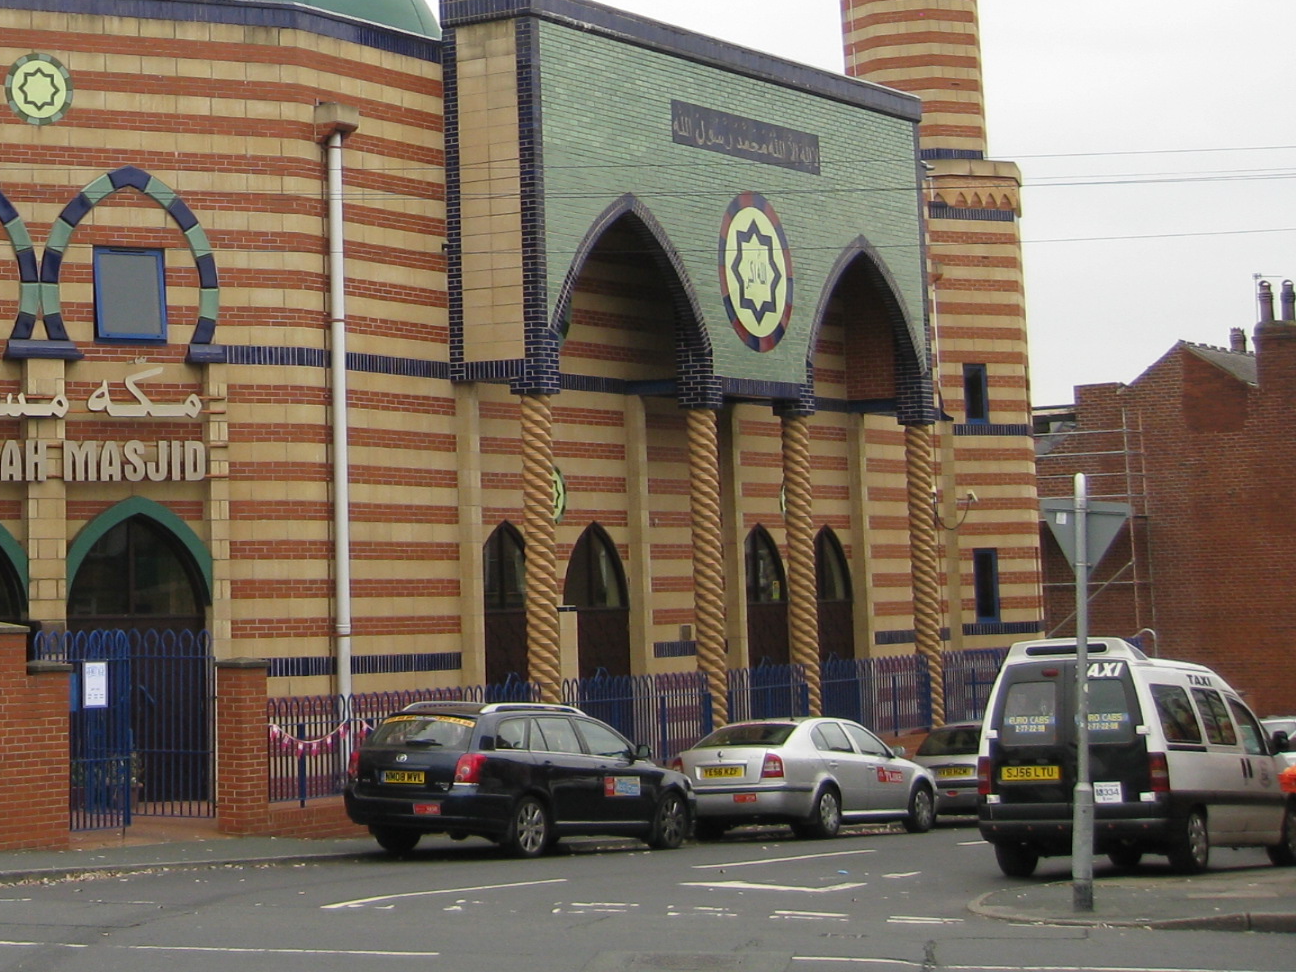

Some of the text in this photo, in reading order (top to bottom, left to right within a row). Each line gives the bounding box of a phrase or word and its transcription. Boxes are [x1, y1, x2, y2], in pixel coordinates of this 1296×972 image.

[63, 440, 206, 482] MASJID
[1077, 662, 1124, 678] AXI
[1186, 674, 1213, 687] TAXI
[1029, 715, 1050, 724] CABS
[1101, 713, 1123, 722] CABS
[1006, 767, 1054, 778] SJ56 LTU
